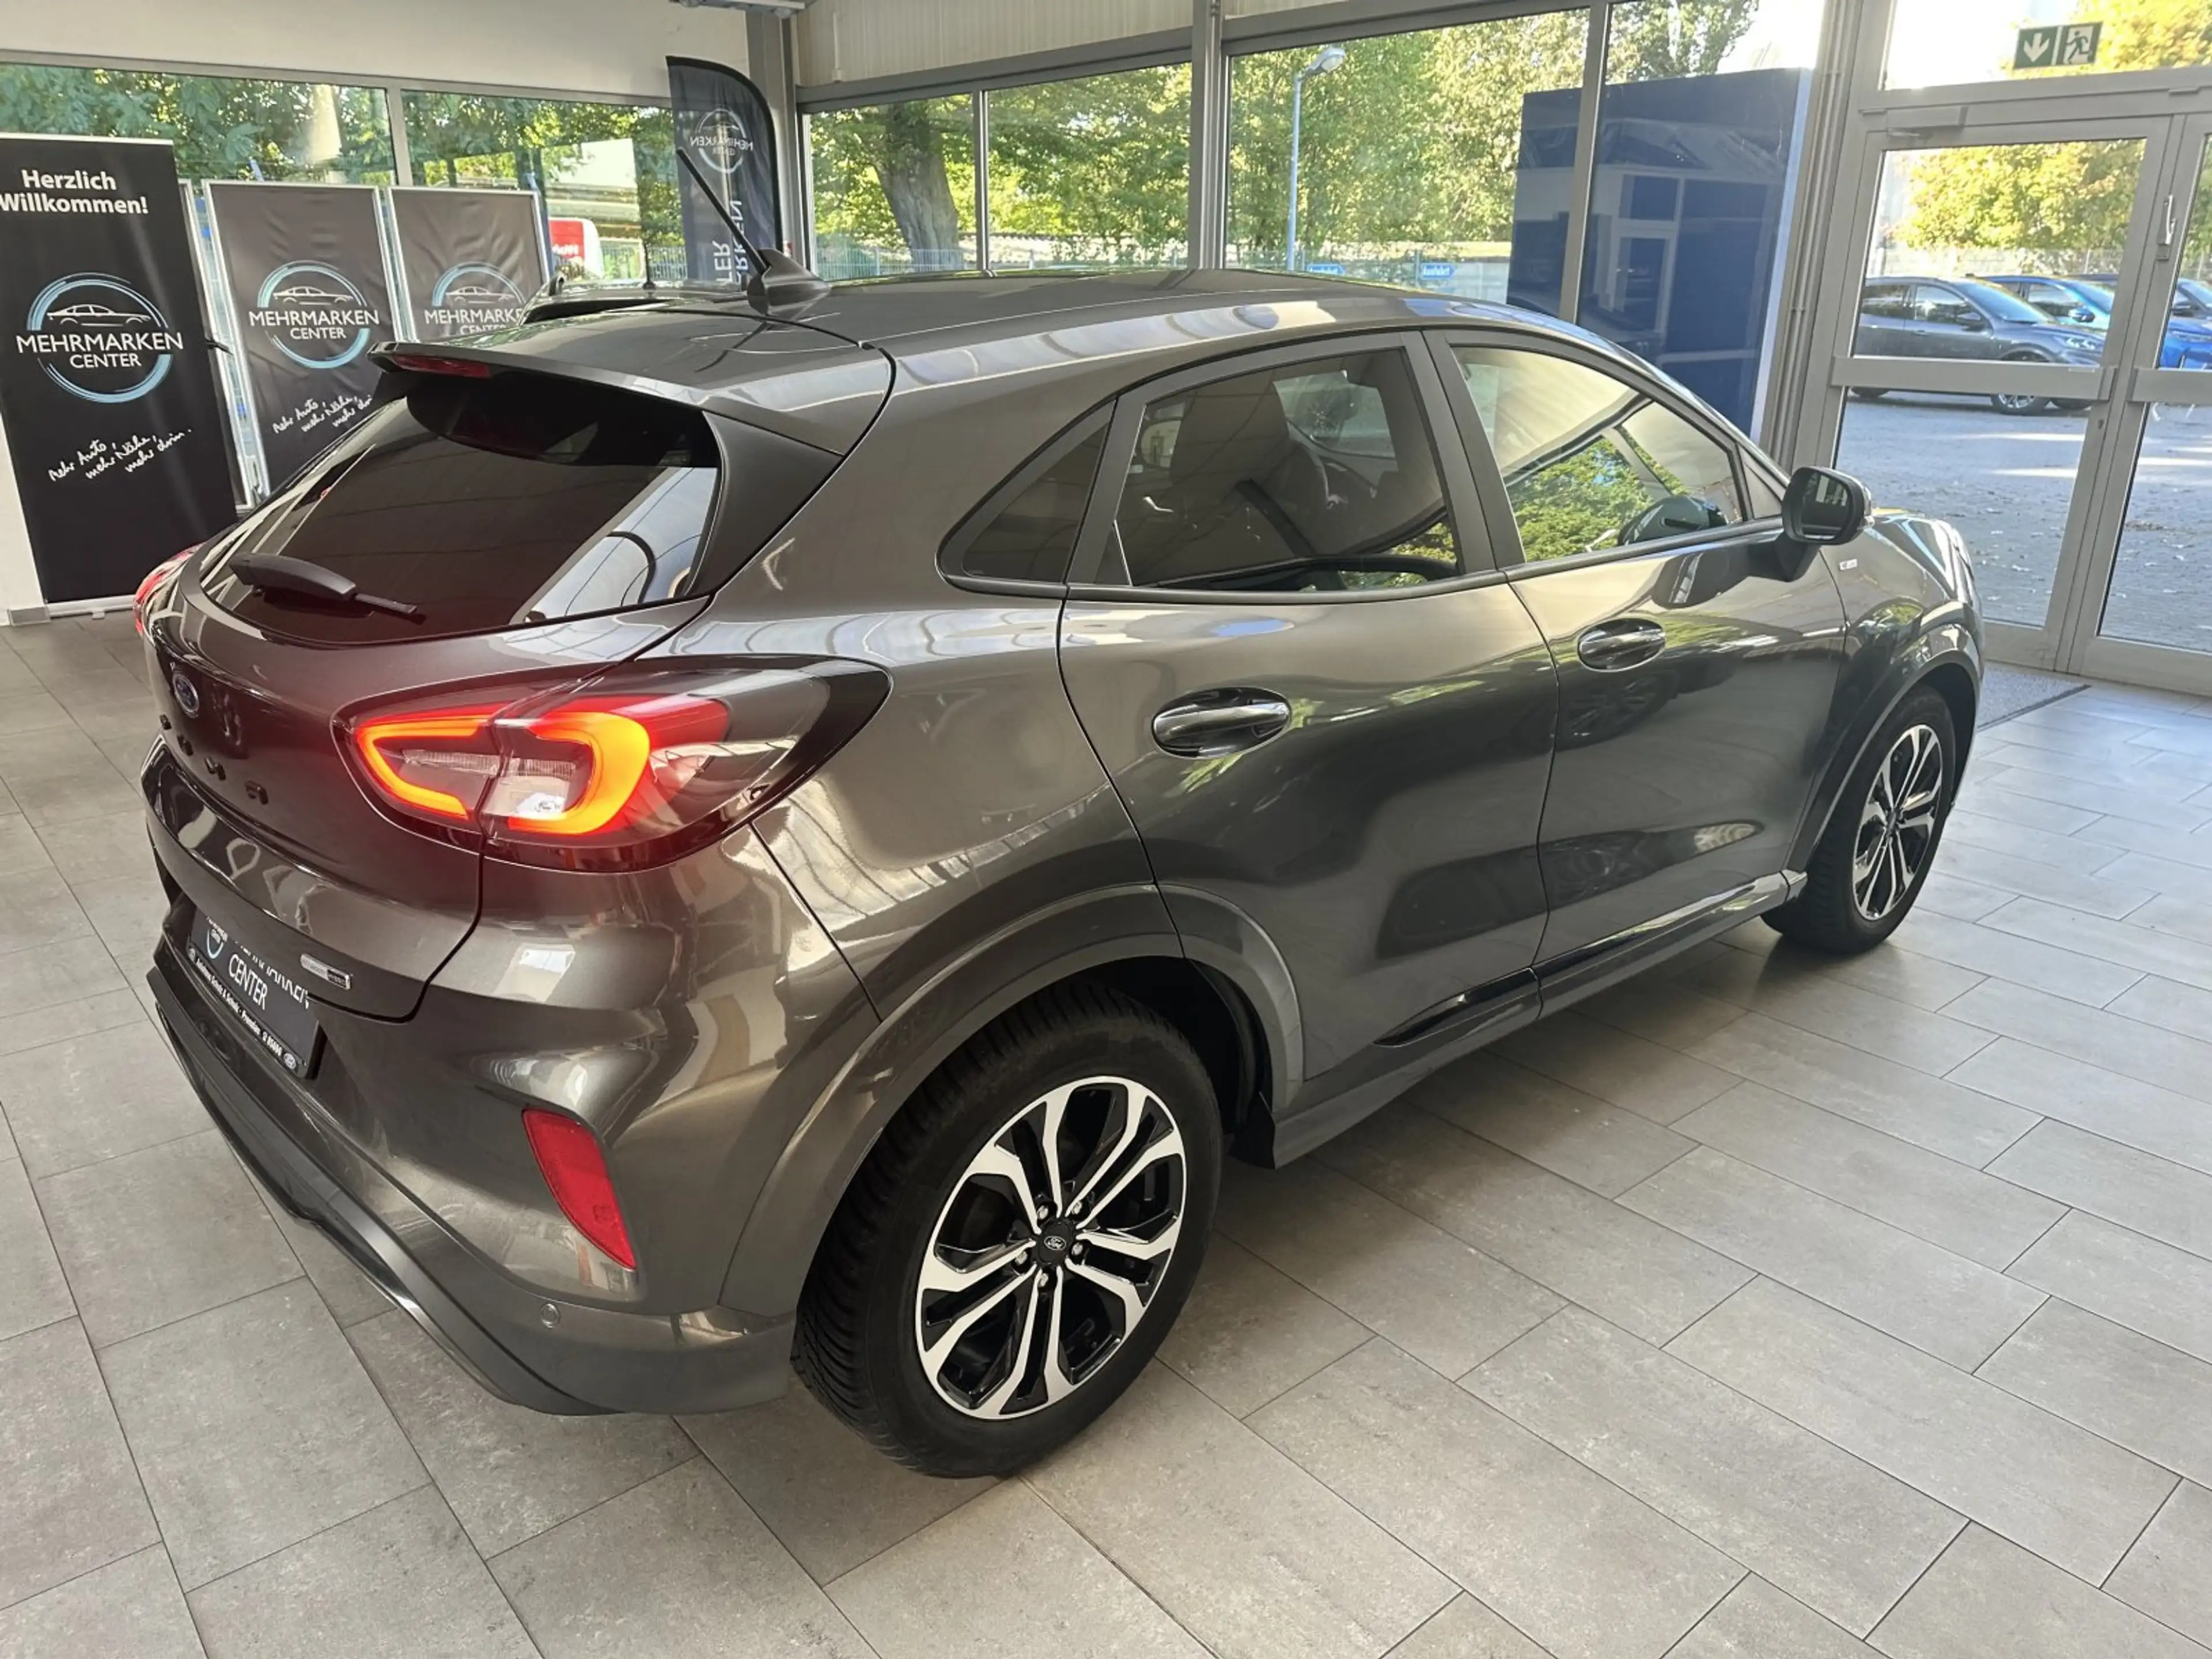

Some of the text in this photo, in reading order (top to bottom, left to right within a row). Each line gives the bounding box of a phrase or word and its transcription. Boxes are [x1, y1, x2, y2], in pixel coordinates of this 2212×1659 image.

[21, 169, 117, 190] Herzlich
[0, 192, 149, 214] Willkommen!
[248, 309, 380, 327] MEHRMARKEN
[424, 308, 523, 325] MEHRMARKE
[16, 332, 184, 353] MEHRMARKEN
[290, 327, 347, 340] CENTER
[69, 353, 142, 369] CENTER
[229, 953, 268, 1010] CENTER
